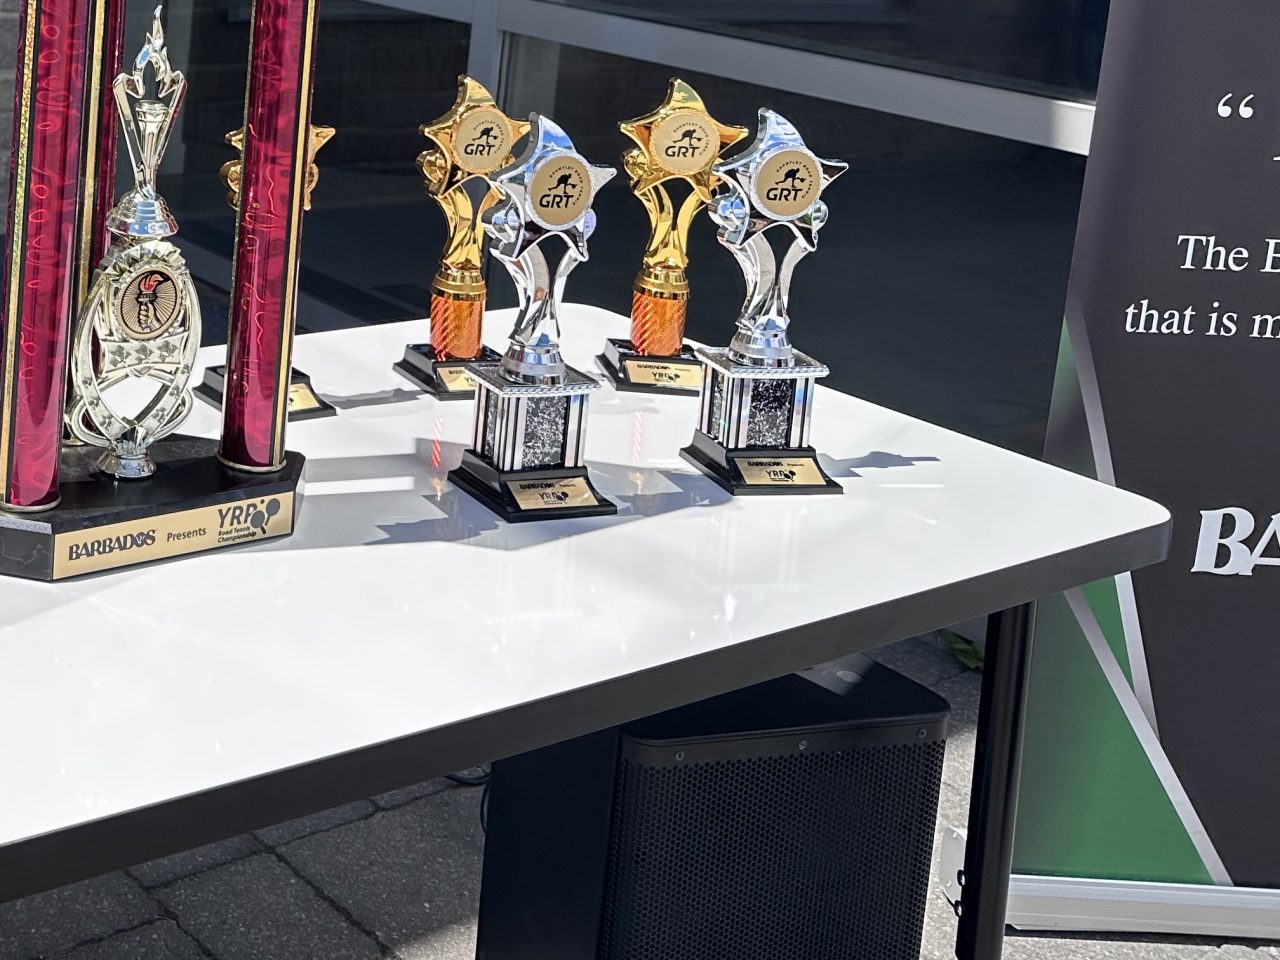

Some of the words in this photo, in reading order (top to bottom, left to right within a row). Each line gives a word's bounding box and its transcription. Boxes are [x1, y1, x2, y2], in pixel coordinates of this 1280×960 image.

[464, 143, 496, 156] GRT
[664, 145, 700, 158] GRT
[539, 194, 574, 208] GRT
[766, 187, 803, 201] GRT
[1177, 234, 1249, 272] The
[1125, 299, 1196, 335] that
[1205, 301, 1238, 337] is
[68, 529, 157, 561] BARBADOS
[167, 527, 206, 543] Presents
